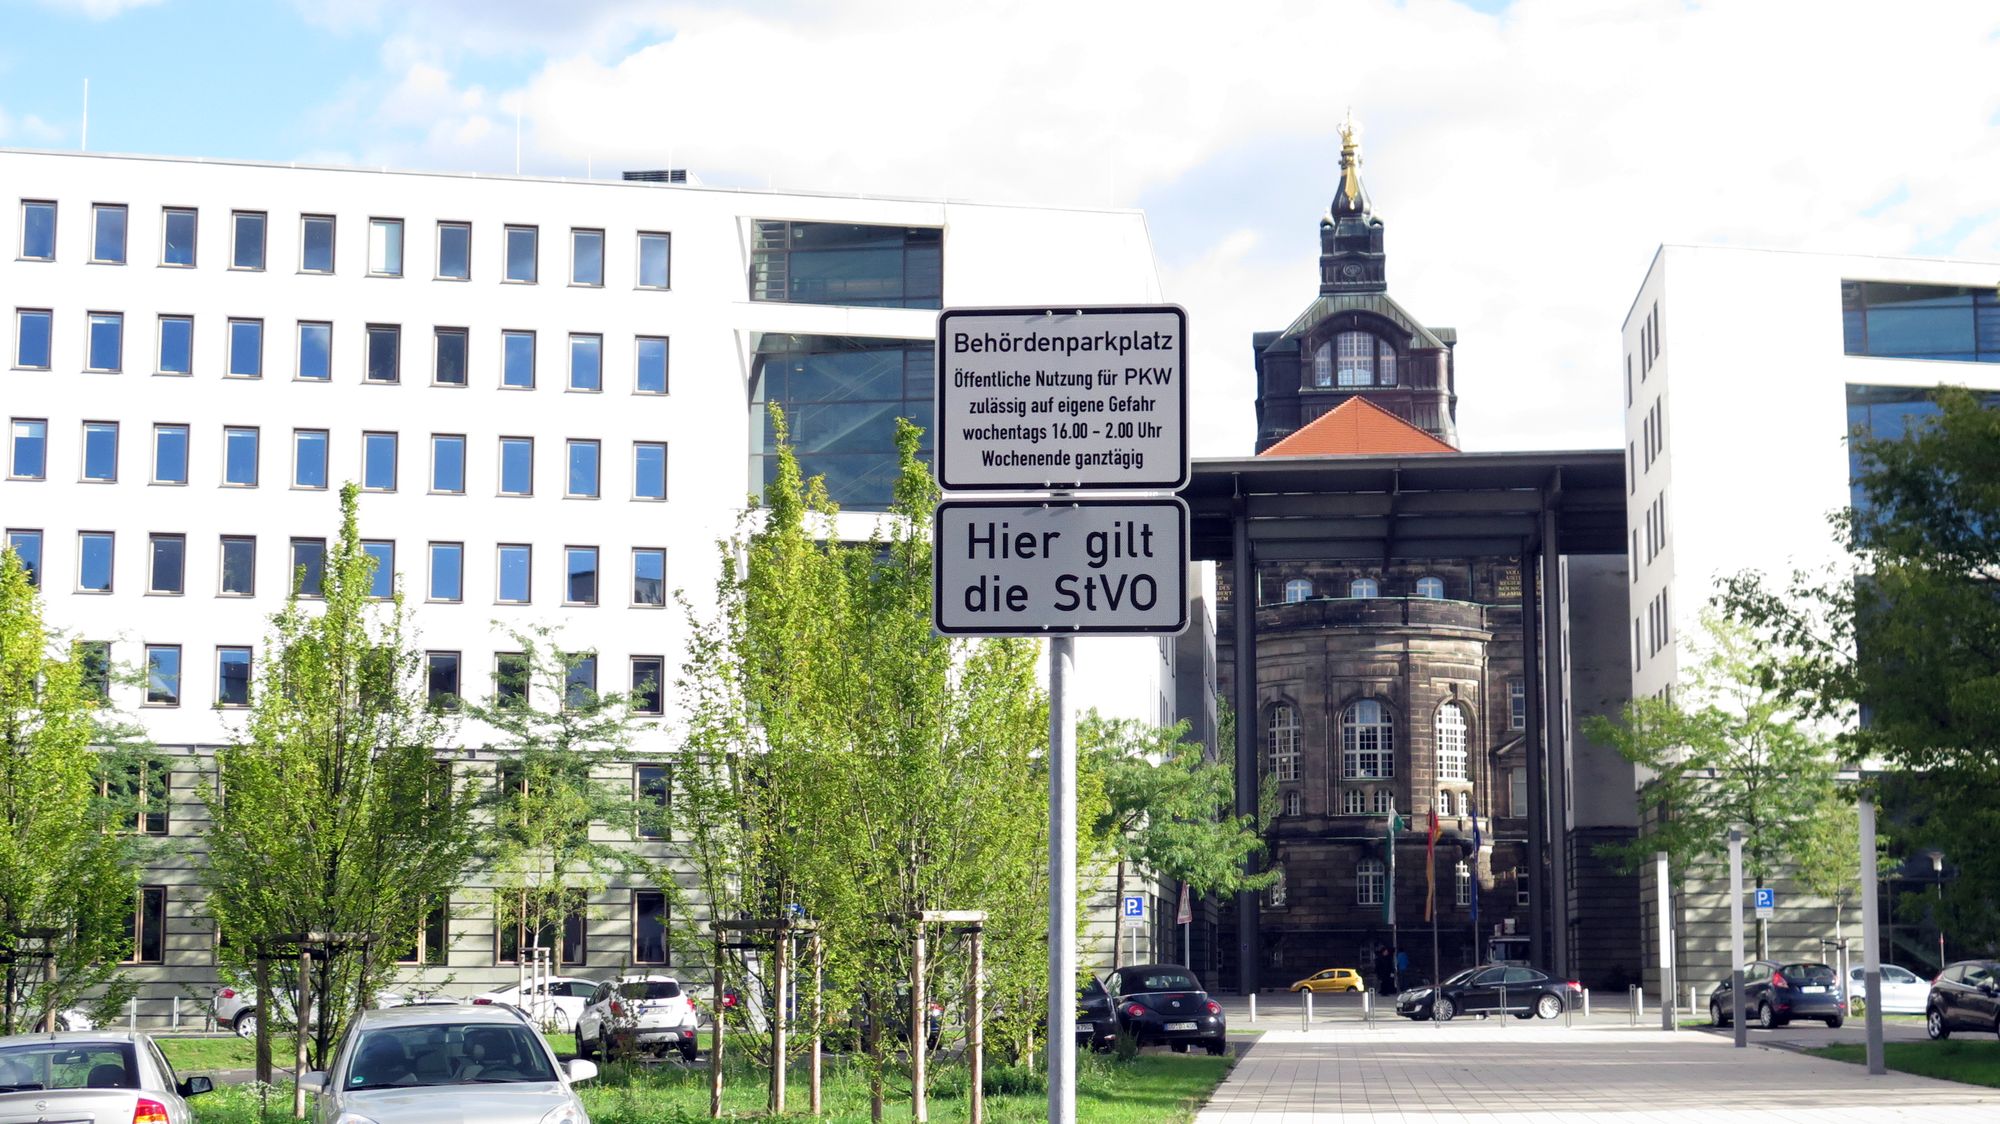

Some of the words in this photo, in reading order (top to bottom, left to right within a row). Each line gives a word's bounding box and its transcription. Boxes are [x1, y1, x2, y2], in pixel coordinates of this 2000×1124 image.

[954, 330, 1173, 357] Behördenparkplatz
[954, 368, 1031, 388] Öffentliche
[1035, 370, 1093, 390] Nutzung
[1097, 369, 1119, 386] für
[1124, 367, 1173, 386] PKW
[969, 397, 1027, 418] zulässig
[1030, 397, 1054, 414] auf
[1057, 397, 1104, 417] eigene
[1108, 395, 1156, 413] Gefahr
[962, 423, 1047, 444] wochentags
[1051, 422, 1088, 440] 16.00
[1105, 422, 1134, 439] 2.00
[1137, 421, 1163, 439] Uhr
[981, 449, 1071, 467] Wochenende
[1075, 448, 1144, 470] ganztägig
[967, 521, 1062, 560] Hier
[1085, 520, 1154, 569] gilt
[964, 574, 1029, 613] die
[1053, 573, 1158, 613] StVO
